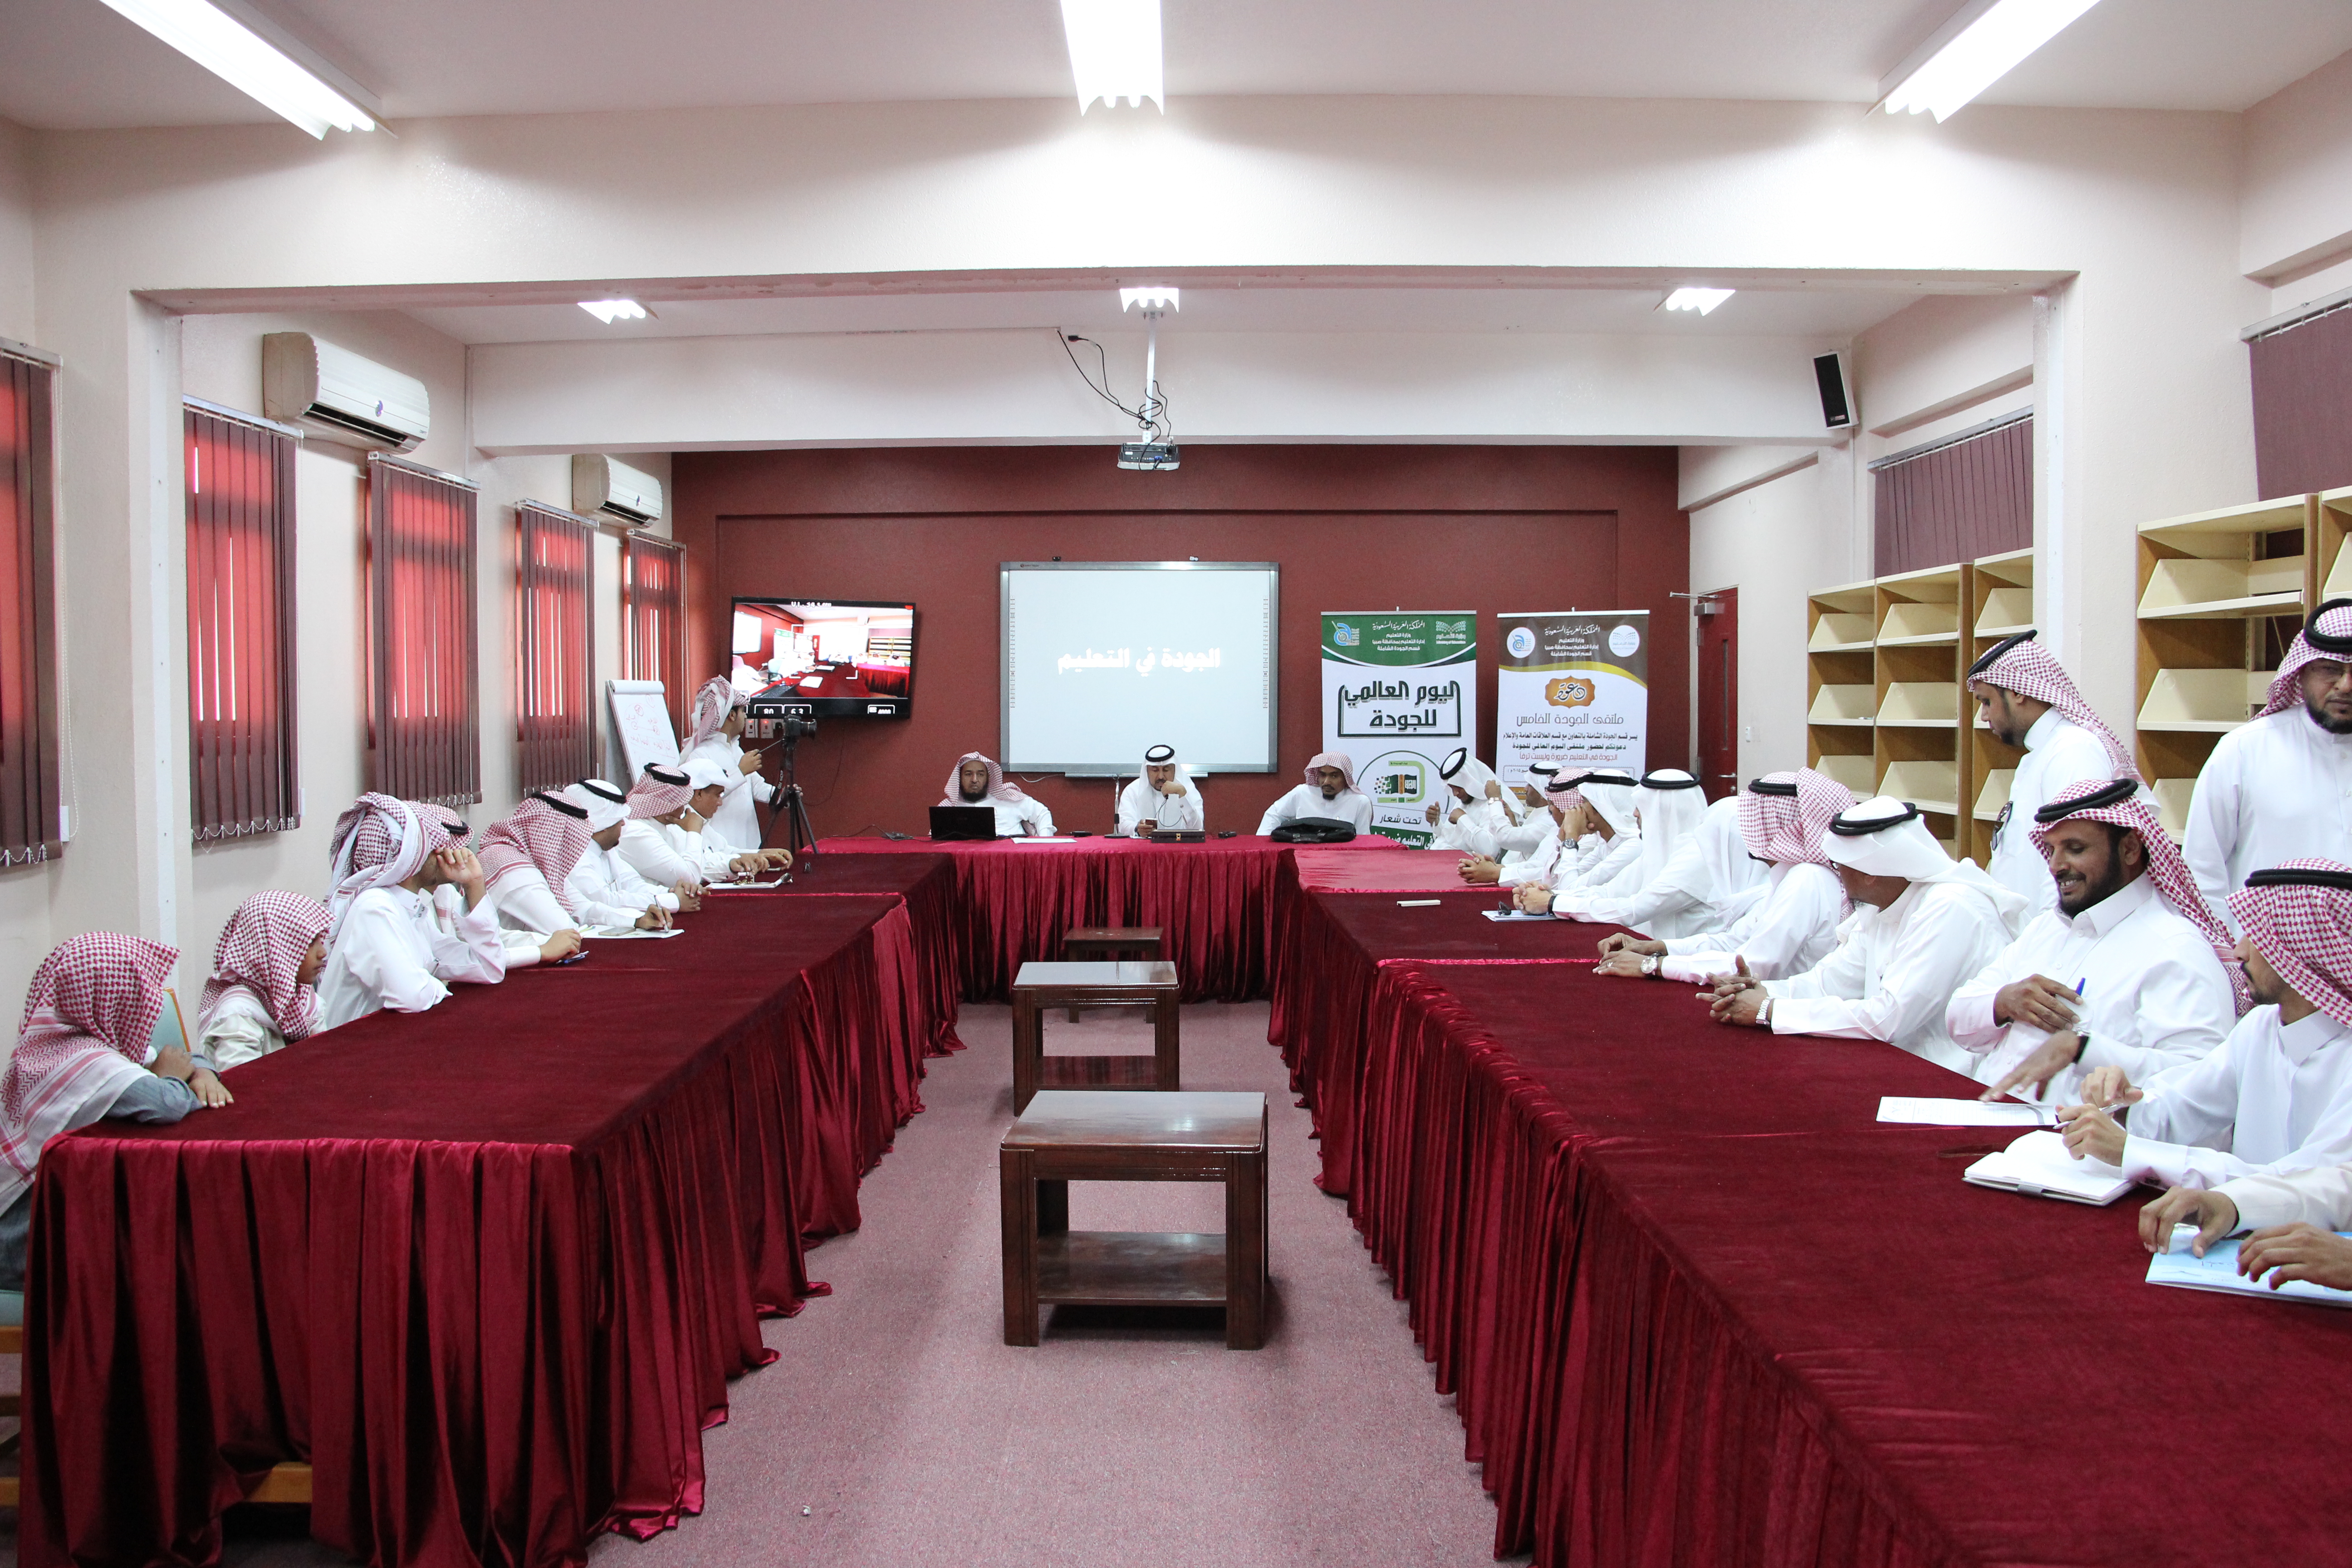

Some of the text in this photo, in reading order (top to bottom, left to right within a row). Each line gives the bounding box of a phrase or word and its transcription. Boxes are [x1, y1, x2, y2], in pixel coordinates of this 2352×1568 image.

[1372, 620, 1425, 630] المملكة العربية السعودية
[1544, 624, 1600, 635] المملكة العربية السعودية
[1057, 647, 1220, 677] الجودة في التعليم
[1344, 680, 1409, 708] العالمي
[1553, 682, 1586, 701] دعوة
[1369, 709, 1437, 732] للجودة
[1516, 713, 1624, 727] ملتقى الجودة الخامس
[1603, 732, 1617, 740] الجودة
[1618, 732, 1627, 740] قسم
[1532, 743, 1550, 751] العالمي
[1605, 743, 1626, 751] دعوتكم
[1531, 753, 1550, 761] وليست
[1551, 753, 1568, 761] ضرورة
[1589, 754, 1598, 762] في
[1379, 813, 1422, 825] تحت شعار
[1401, 834, 1425, 847] التعليم
